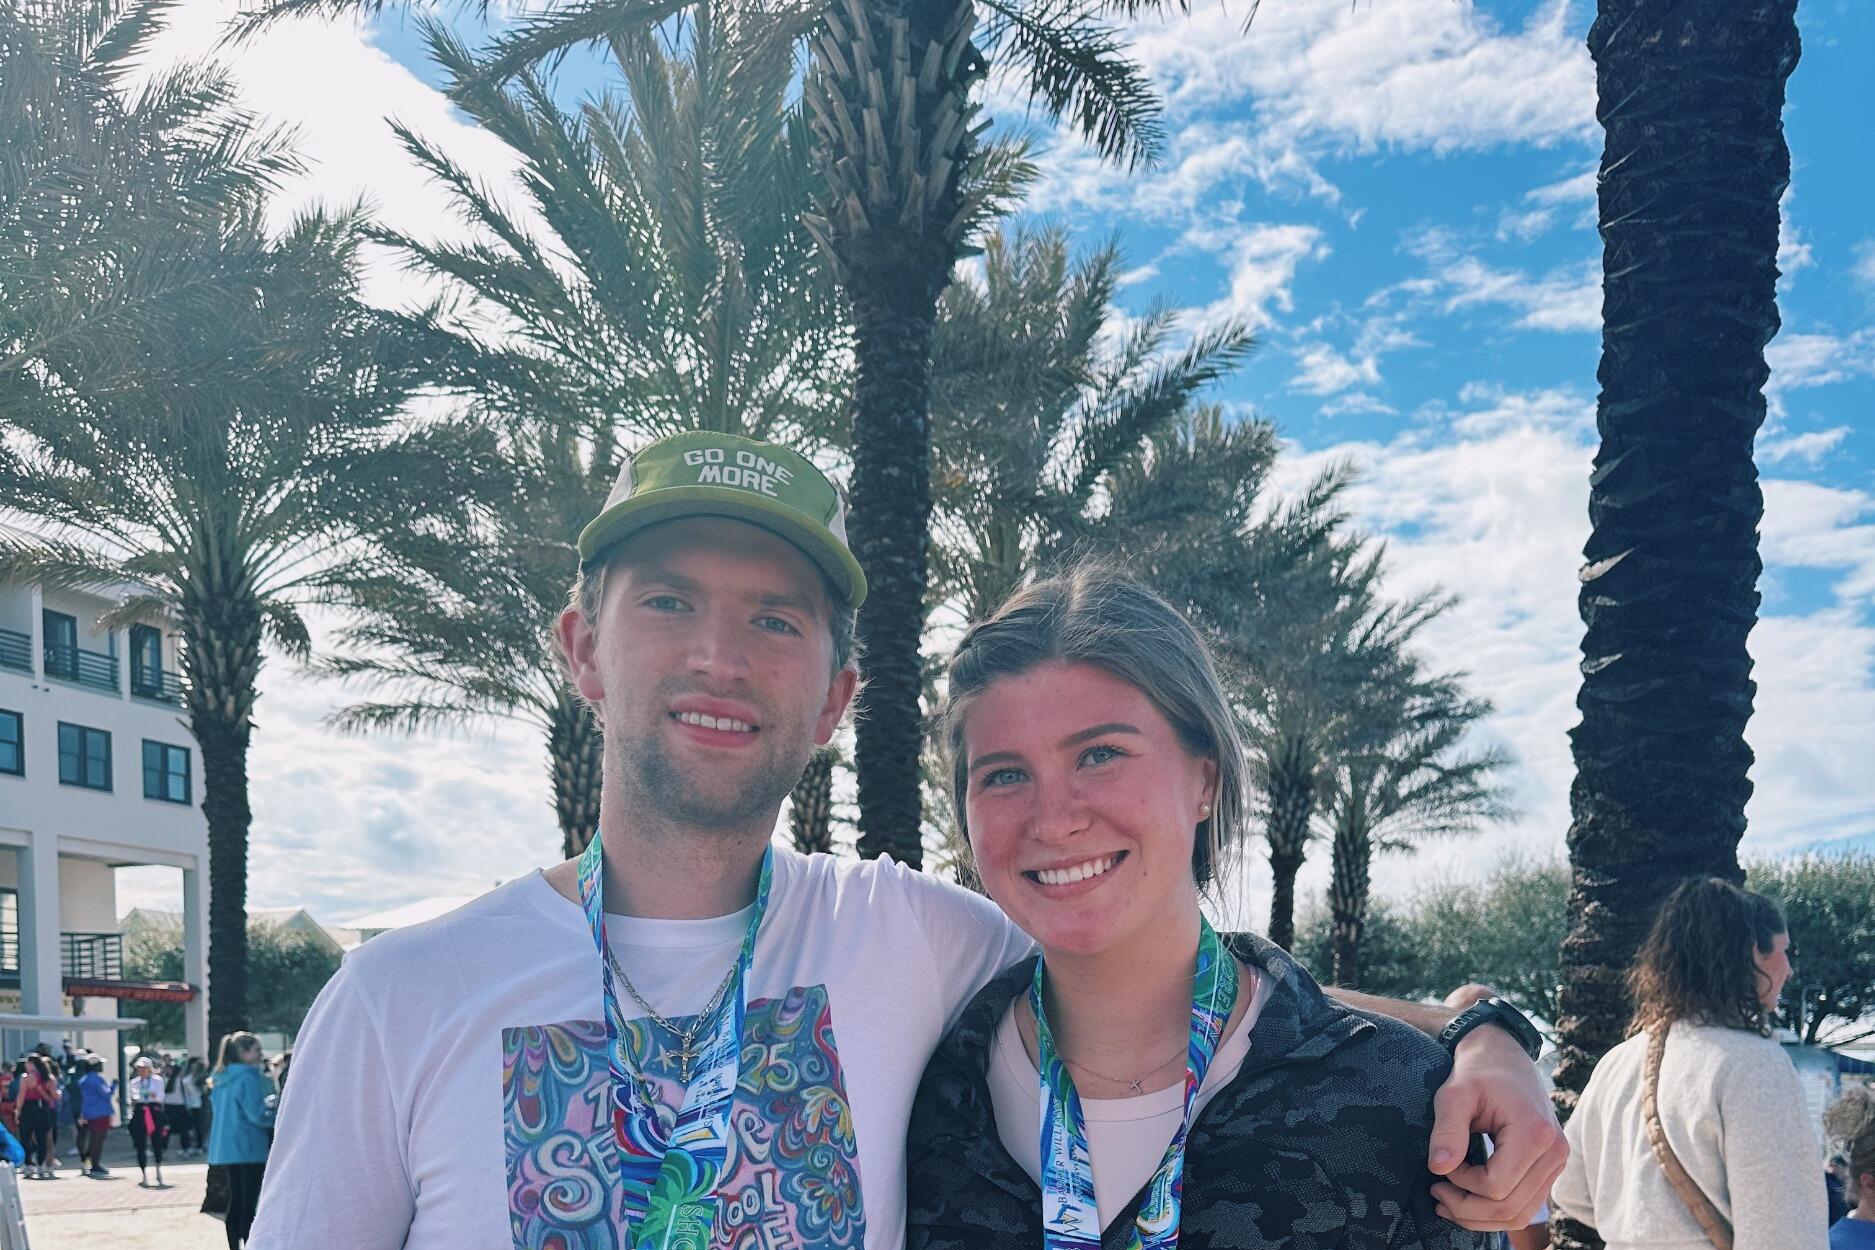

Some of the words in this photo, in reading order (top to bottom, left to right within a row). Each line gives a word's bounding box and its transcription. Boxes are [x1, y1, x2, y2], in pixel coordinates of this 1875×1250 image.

[683, 448, 725, 466] GO
[736, 450, 794, 486] ONE
[697, 466, 778, 497] MORE
[737, 1040, 799, 1096] 25
[1052, 1098, 1063, 1156] WILLIAMS
